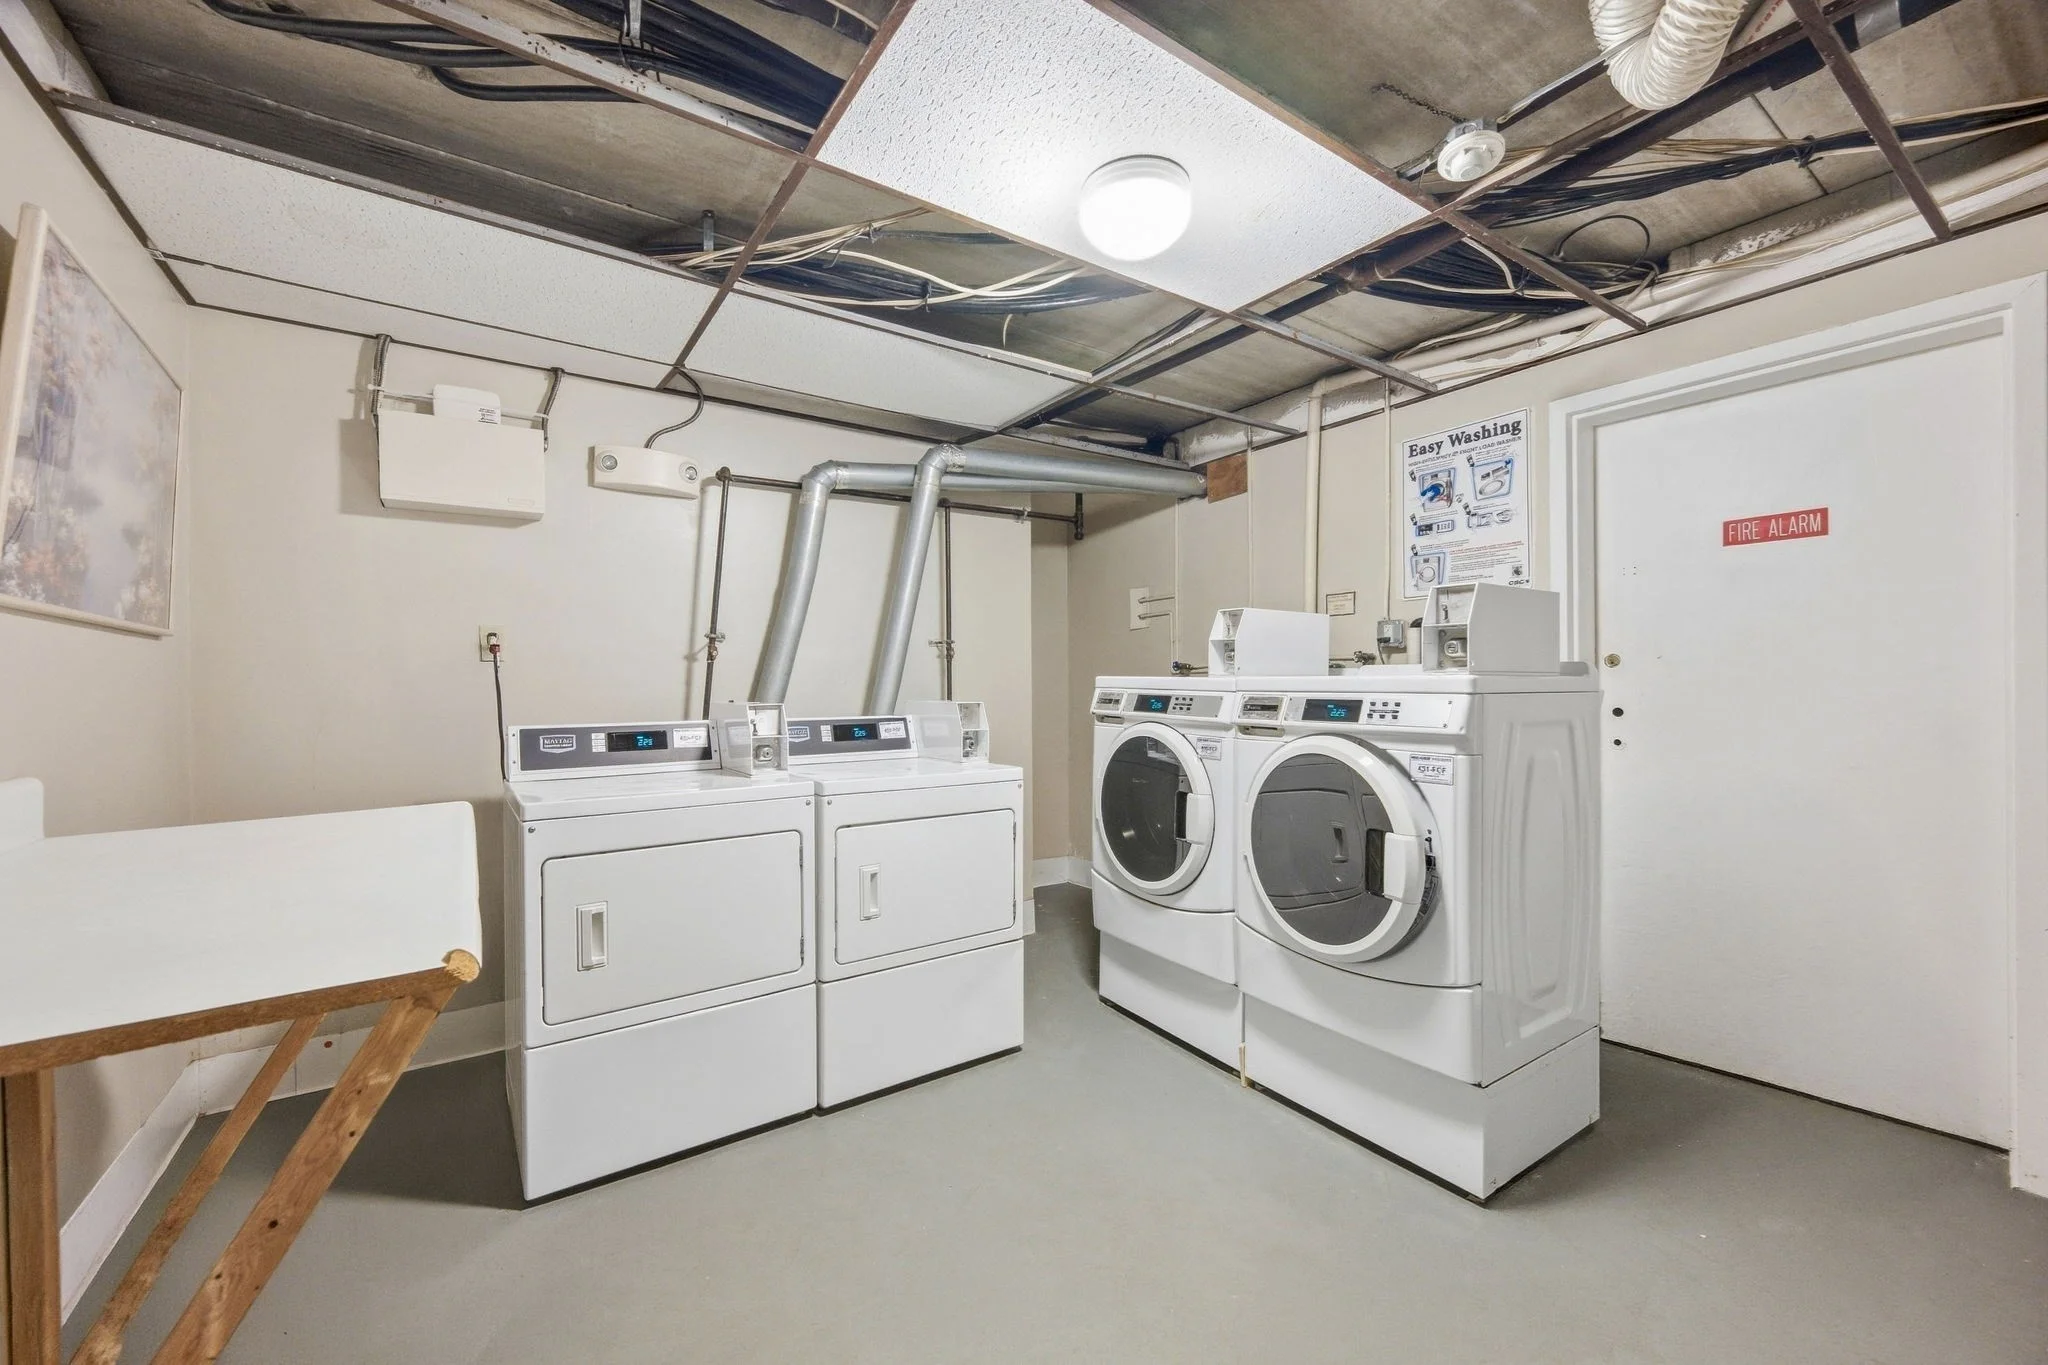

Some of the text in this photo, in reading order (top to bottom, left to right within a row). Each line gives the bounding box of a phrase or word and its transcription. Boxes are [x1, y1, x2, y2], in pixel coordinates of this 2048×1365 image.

[1408, 420, 1522, 459] Easy Washing
[1728, 512, 1821, 543] FIRE ALARM
[543, 737, 573, 745] MAYTAG
